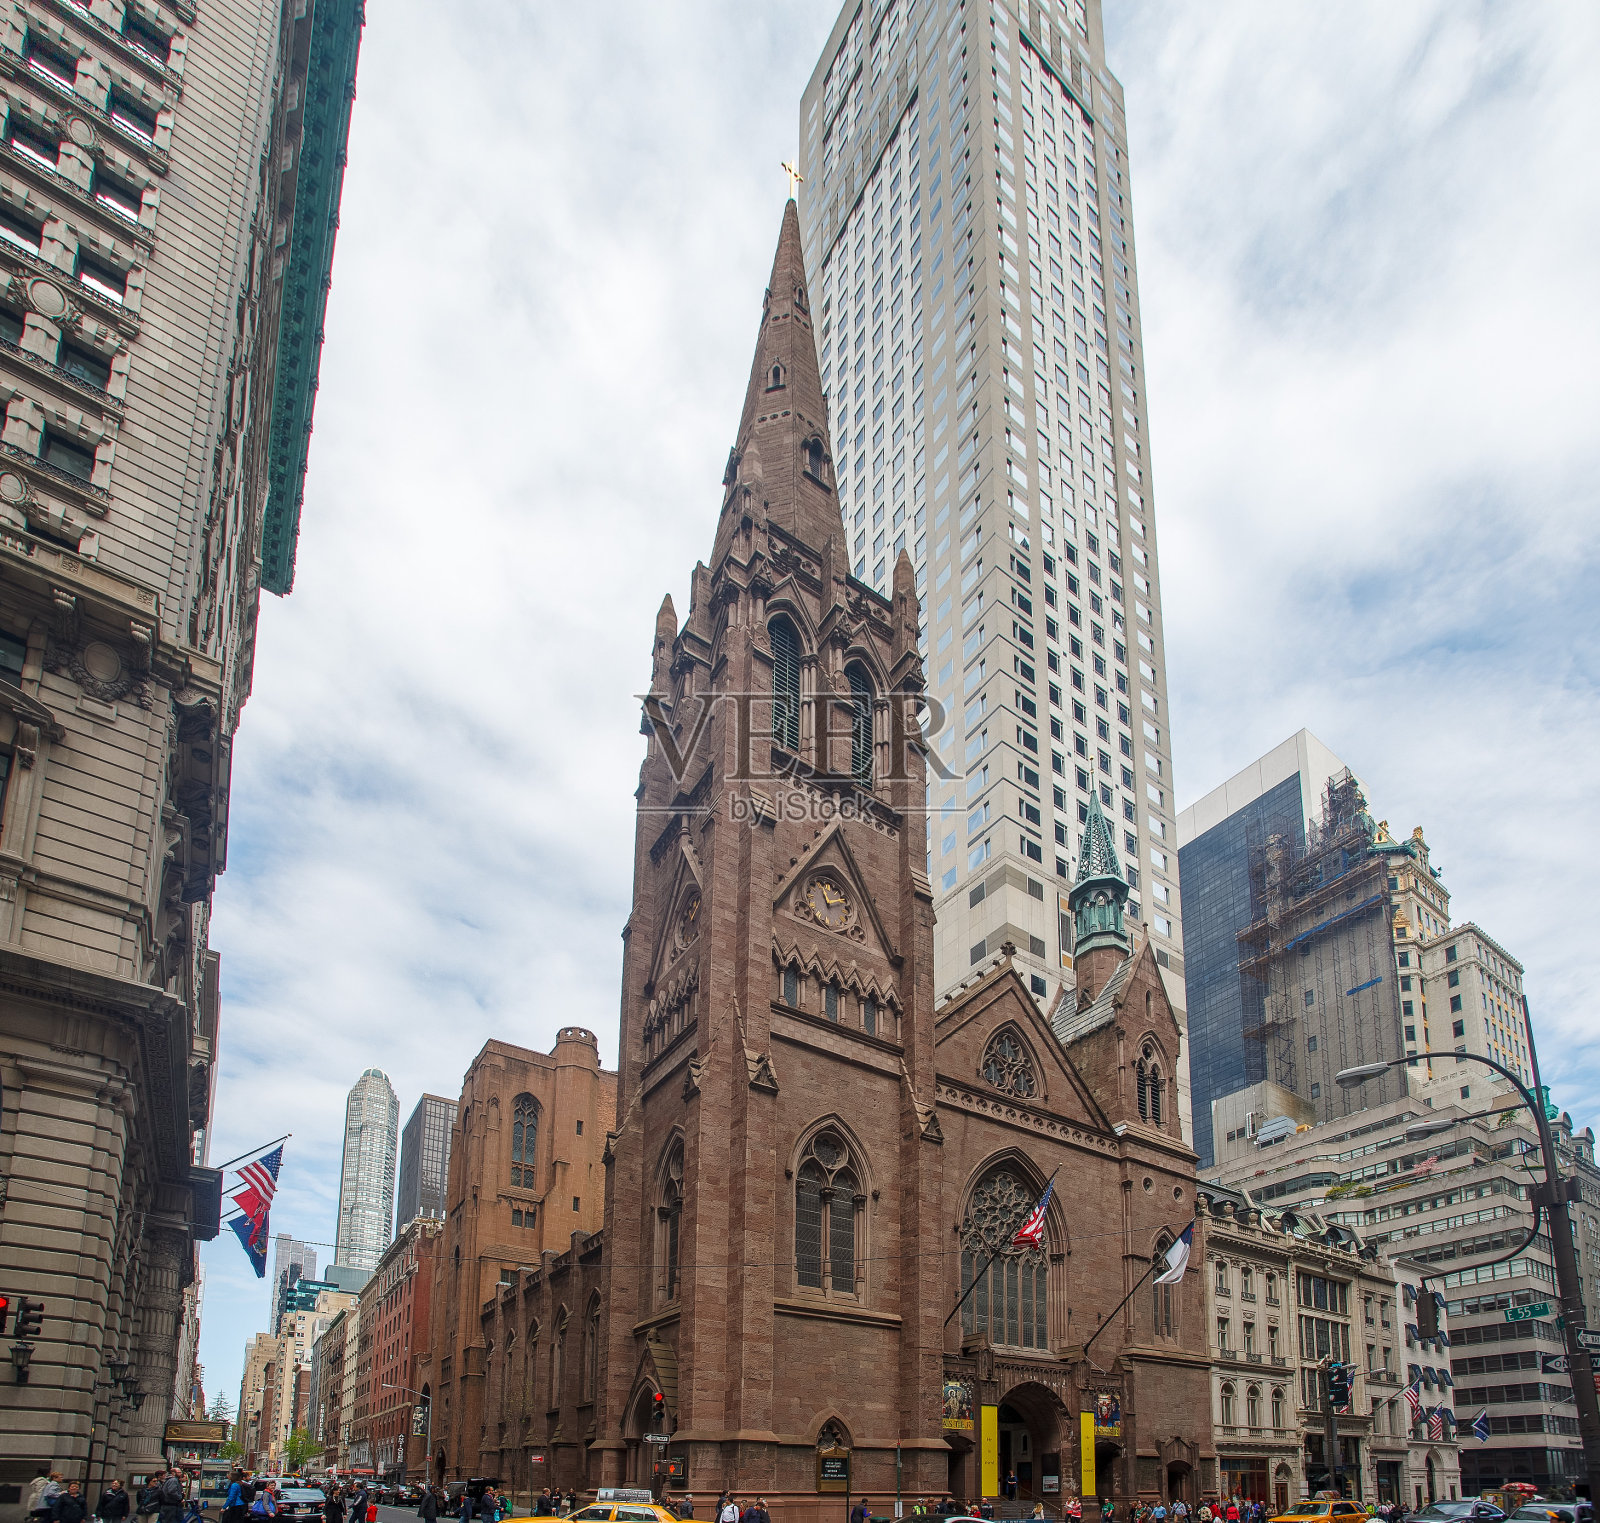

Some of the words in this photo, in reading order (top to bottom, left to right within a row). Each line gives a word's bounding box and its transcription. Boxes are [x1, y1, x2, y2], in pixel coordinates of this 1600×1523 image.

[1507, 1310, 1514, 1320] E
[1517, 1306, 1531, 1318] 55
[1554, 1360, 1569, 1369] ON
